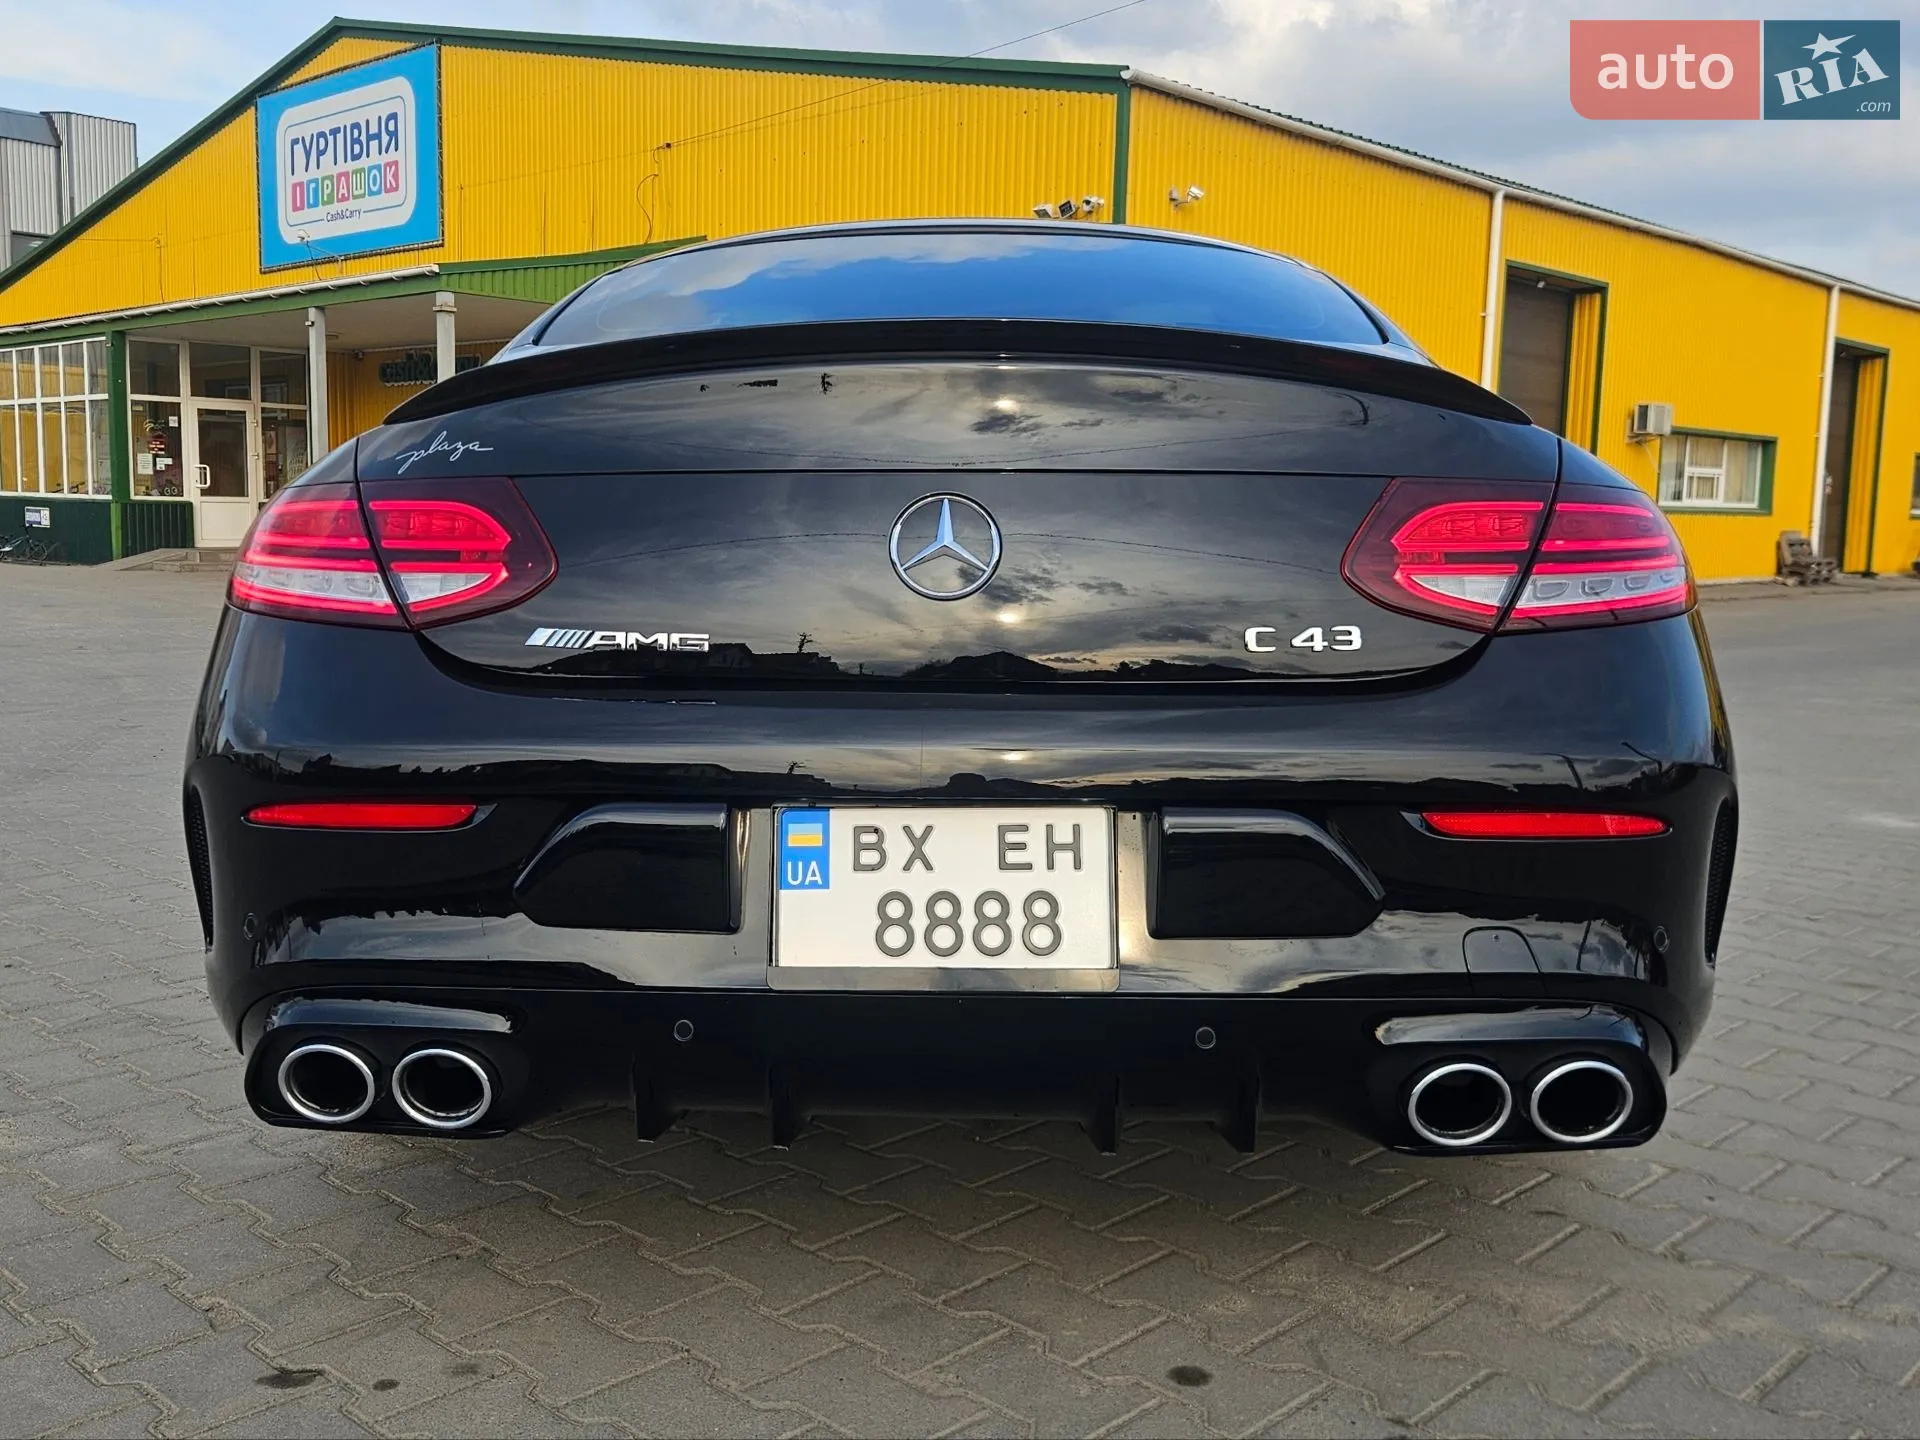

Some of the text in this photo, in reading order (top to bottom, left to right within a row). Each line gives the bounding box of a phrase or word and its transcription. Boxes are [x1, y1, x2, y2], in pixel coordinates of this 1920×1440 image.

[290, 112, 399, 176] ГУРТІВНЯ
[295, 163, 397, 209] ІГРАШОК
[326, 208, 362, 223] Cash&Carry
[584, 630, 710, 652] AMG
[1244, 625, 1362, 653] C 43
[853, 824, 1082, 871] BX EH
[787, 860, 823, 885] UA
[875, 890, 1062, 957] 8888
